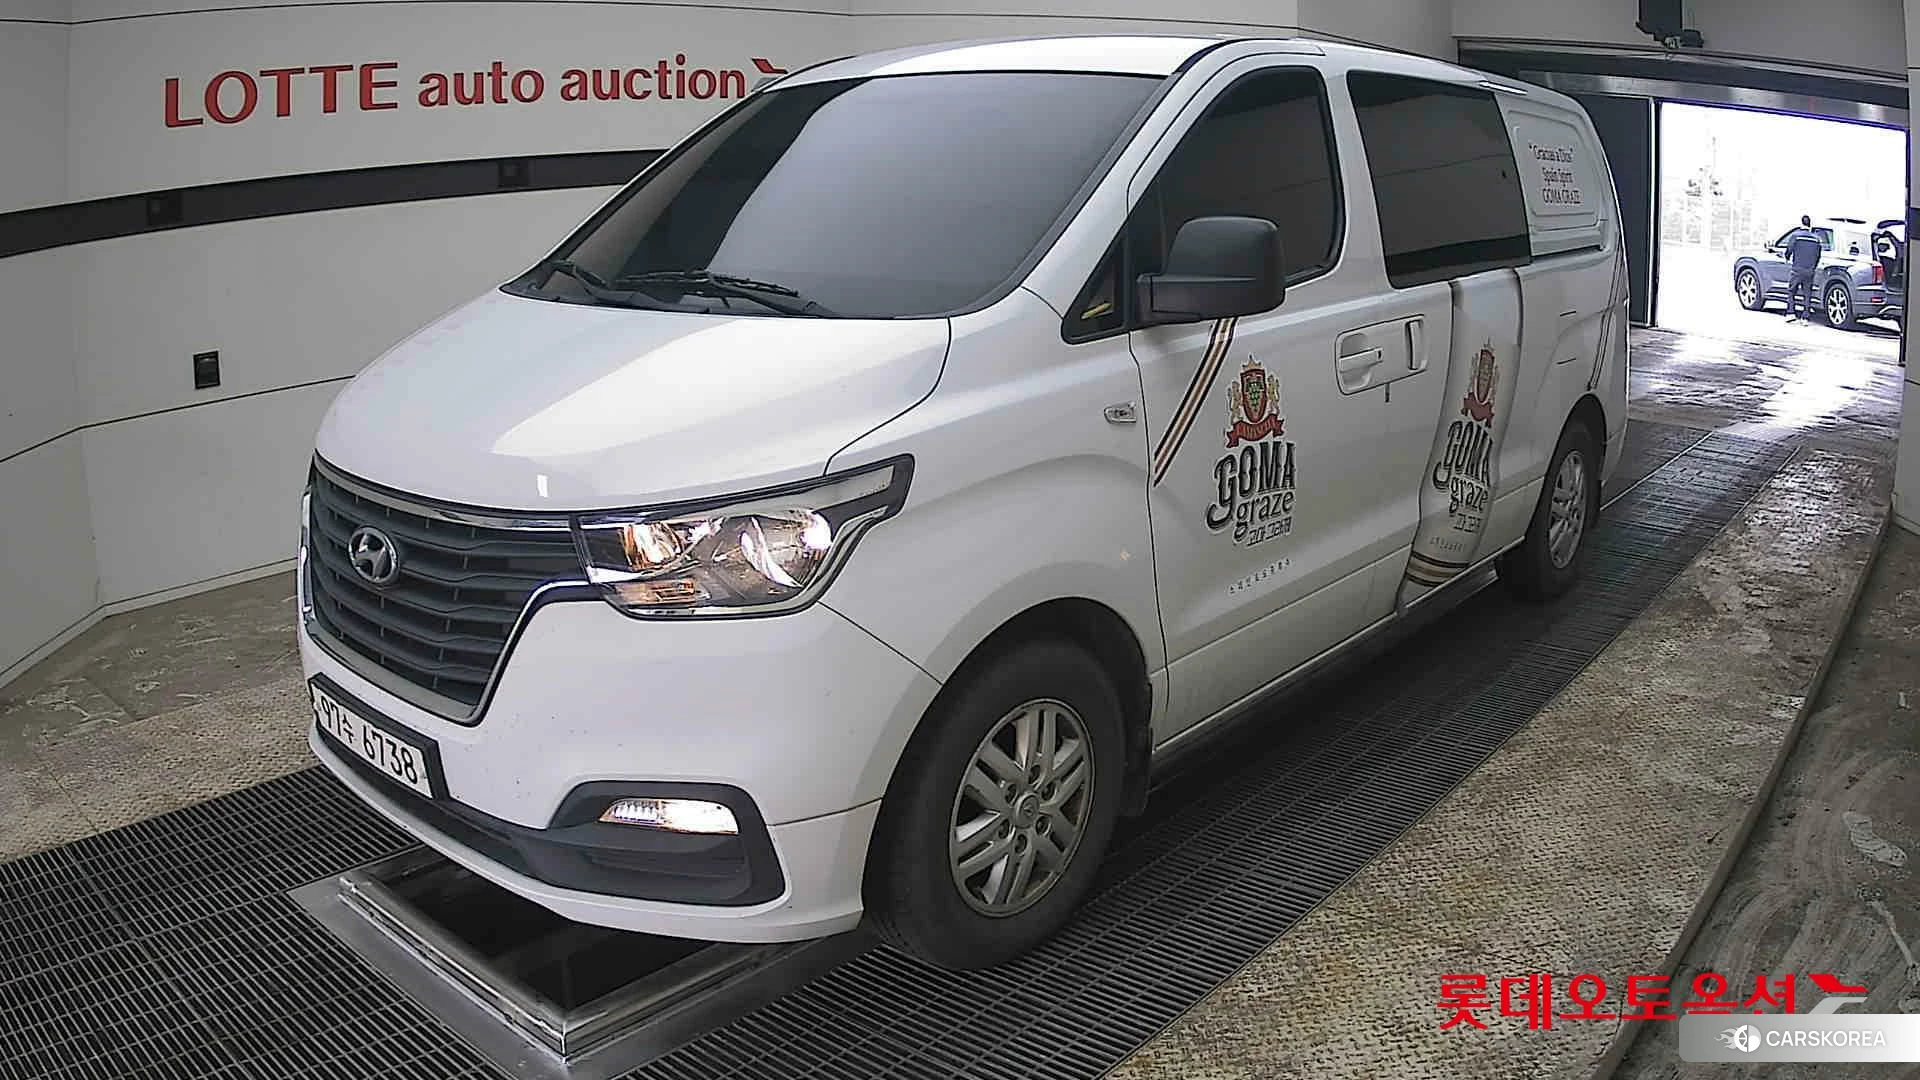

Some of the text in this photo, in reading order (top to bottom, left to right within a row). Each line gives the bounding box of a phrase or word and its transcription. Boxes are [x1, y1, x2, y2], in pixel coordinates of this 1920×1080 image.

[164, 53, 747, 128] LOTTE auto auction
[1206, 440, 1297, 530] GOMA
[1432, 420, 1493, 491] GOMA
[1233, 490, 1294, 543] graze
[1449, 476, 1489, 514] graze
[320, 695, 419, 785] 97수 6738
